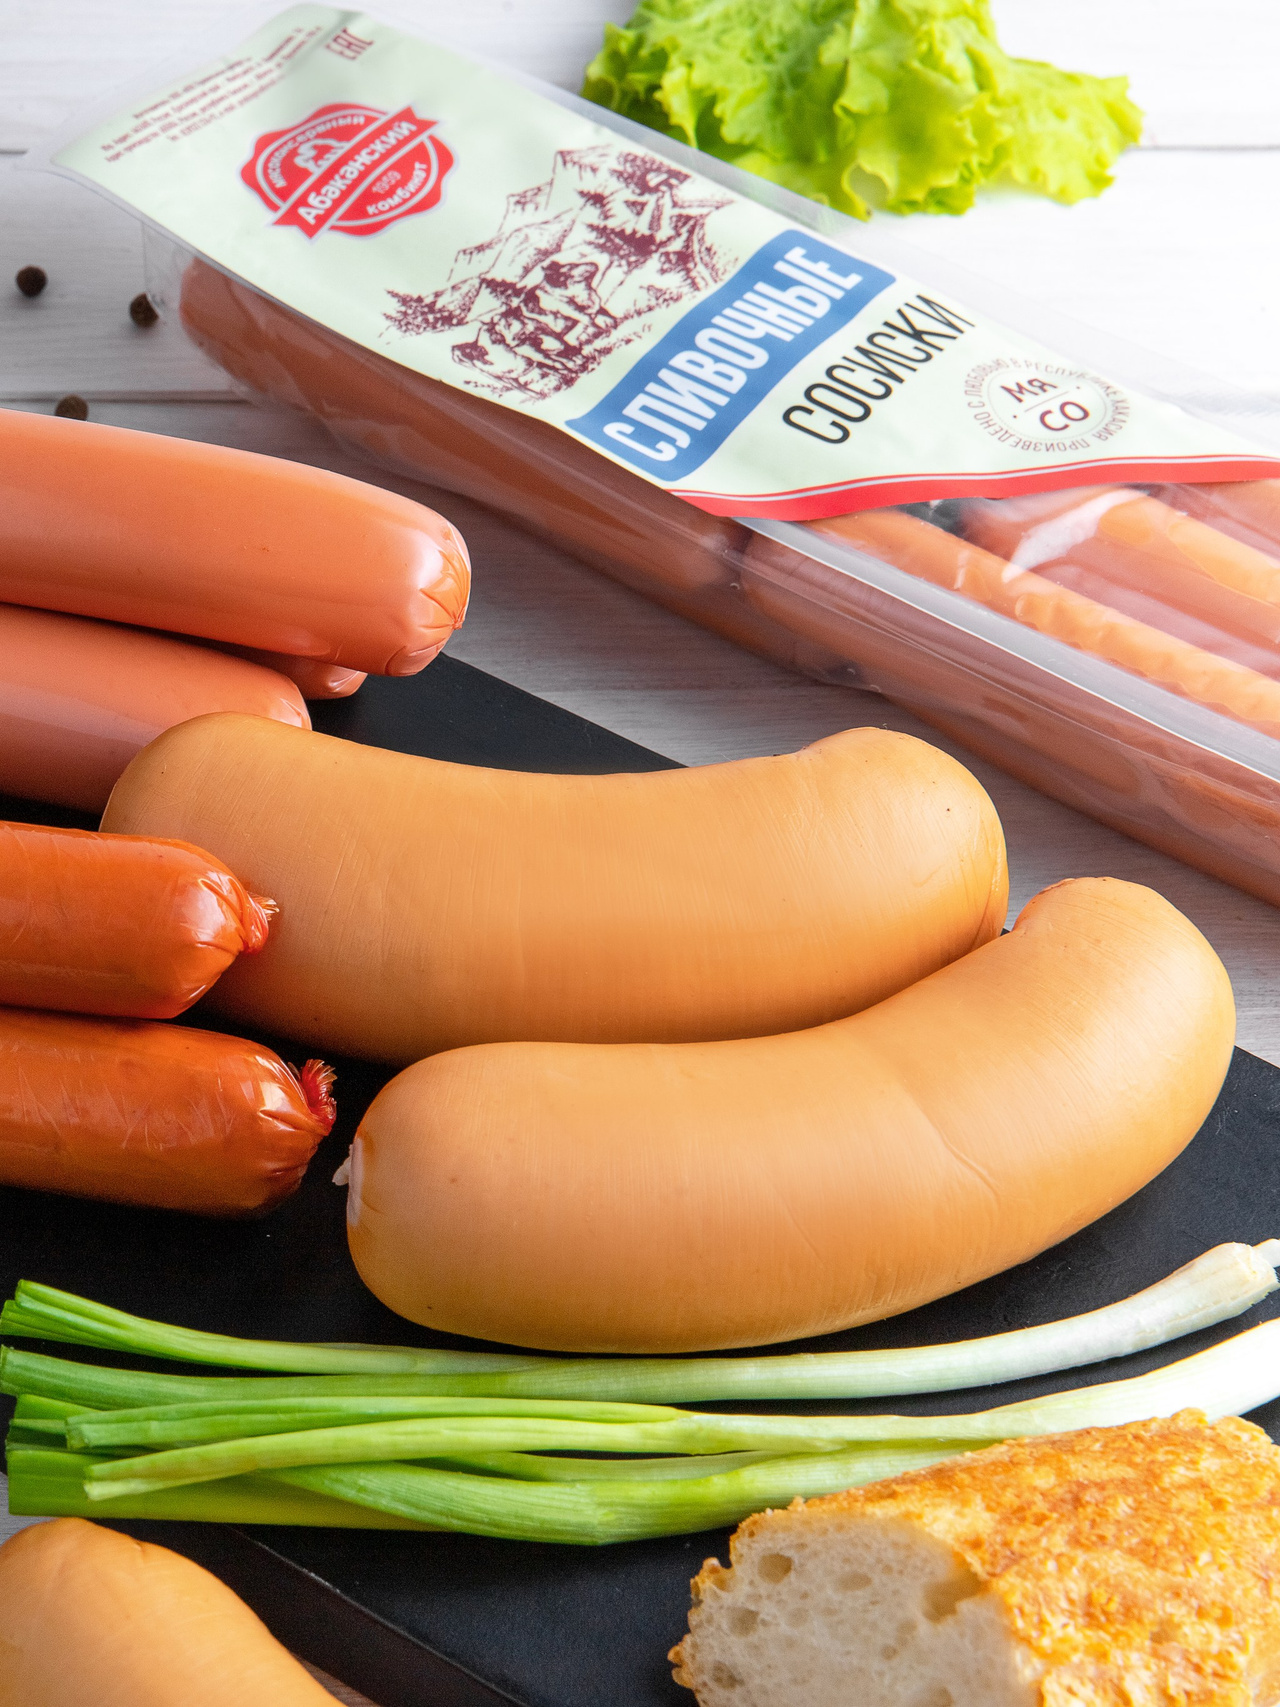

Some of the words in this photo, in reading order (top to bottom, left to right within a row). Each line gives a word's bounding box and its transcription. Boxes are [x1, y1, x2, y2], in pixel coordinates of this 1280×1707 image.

[297, 120, 417, 225] Абаканский
[366, 161, 428, 215] комбинат
[603, 246, 864, 462] СЛИВОЧНЫЕ
[782, 294, 976, 444] СОСИСКИ
[968, 400, 986, 409] С
[1000, 378, 1059, 403] МЯ
[973, 411, 1091, 452] ПРОИЗВЕДЕНО
[1040, 401, 1090, 431] СО
